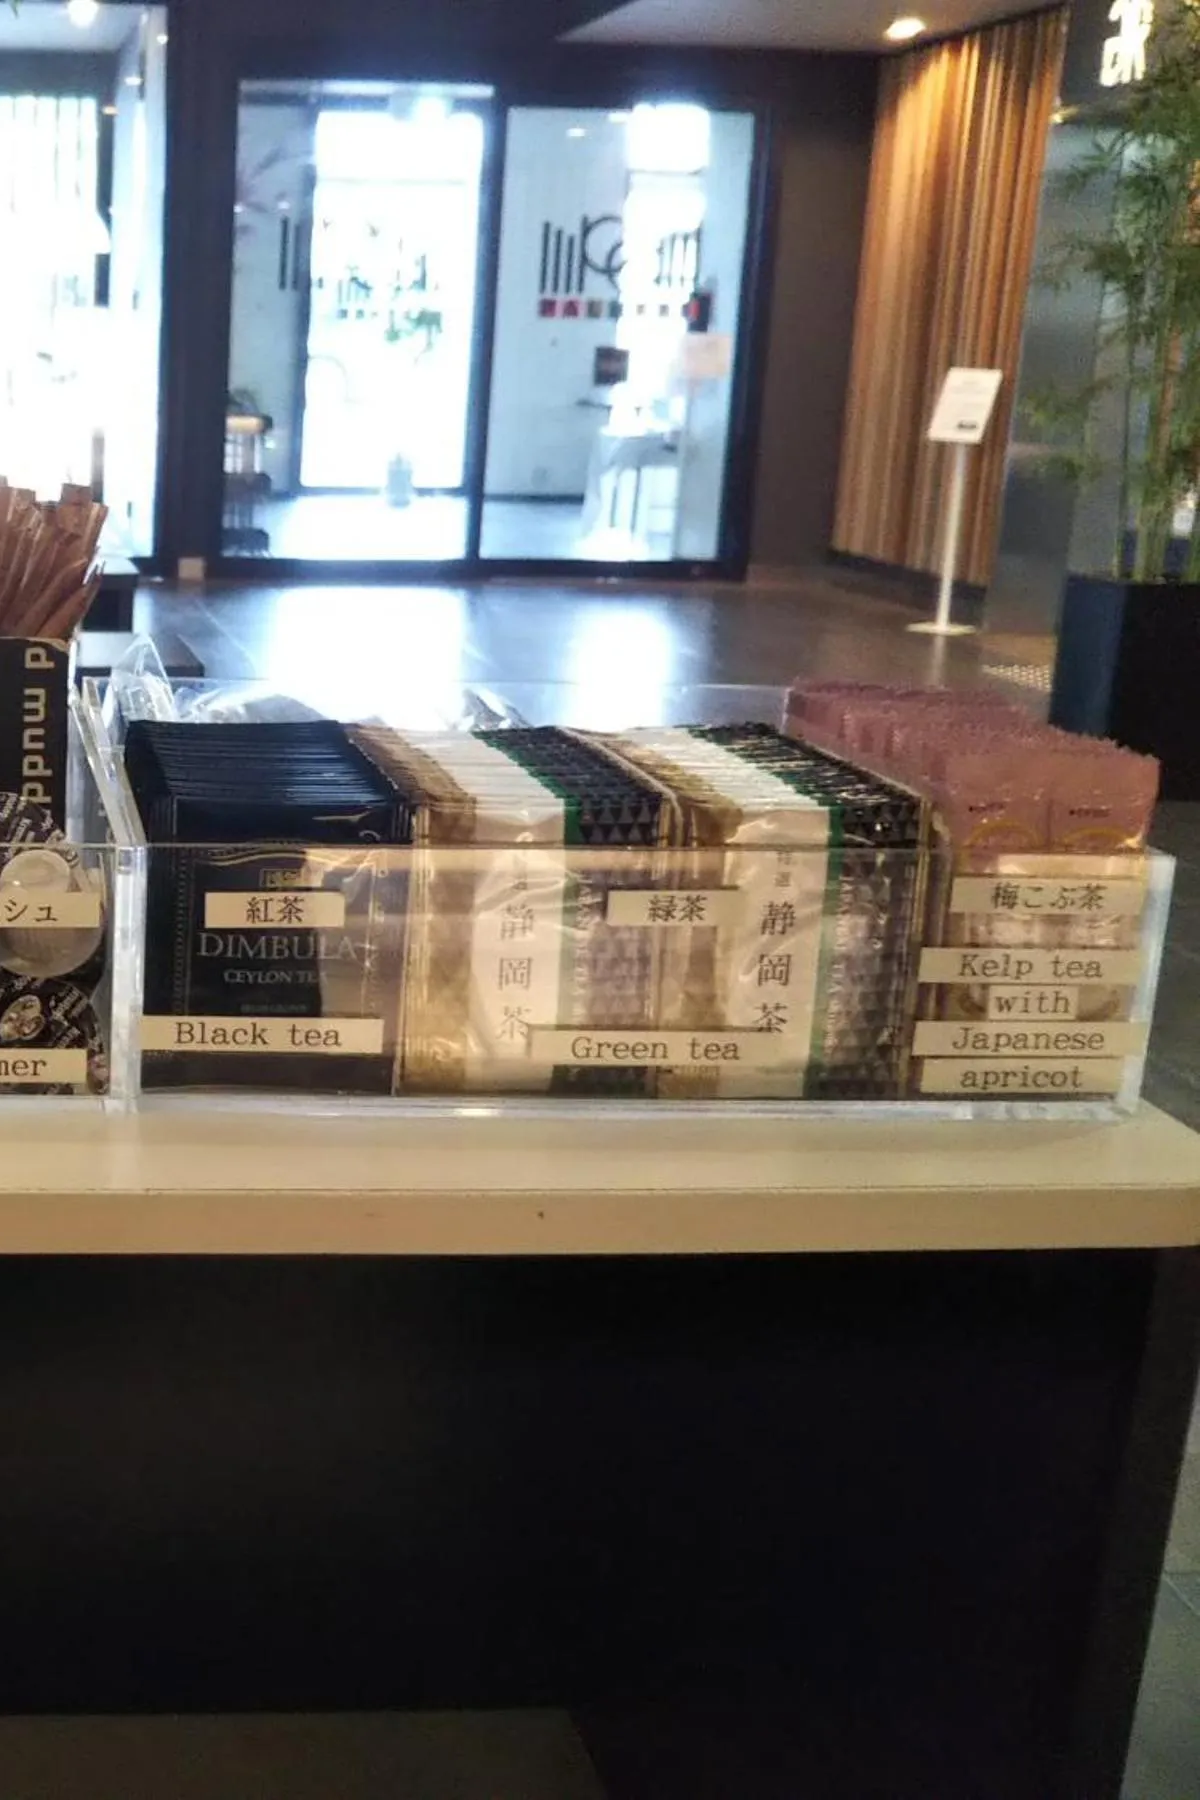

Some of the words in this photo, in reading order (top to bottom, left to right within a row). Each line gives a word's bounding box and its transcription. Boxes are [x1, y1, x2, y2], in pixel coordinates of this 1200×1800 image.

[246, 896, 305, 924] 紅茶
[648, 894, 707, 923] 緑茶
[991, 883, 1108, 911] 梅こぶ茶
[197, 932, 358, 960] DIMBULA
[223, 968, 293, 984] CEYLON
[753, 900, 797, 1035] 静岡茶
[957, 953, 1034, 980] Kelp
[1051, 955, 1104, 979] tea
[994, 990, 1071, 1014] with
[175, 1021, 269, 1046] Black
[288, 1024, 342, 1047] tea
[951, 1027, 1105, 1053] Japanese
[570, 1036, 670, 1060] Green
[690, 1038, 741, 1061] tea
[959, 1064, 1083, 1090] apricot
